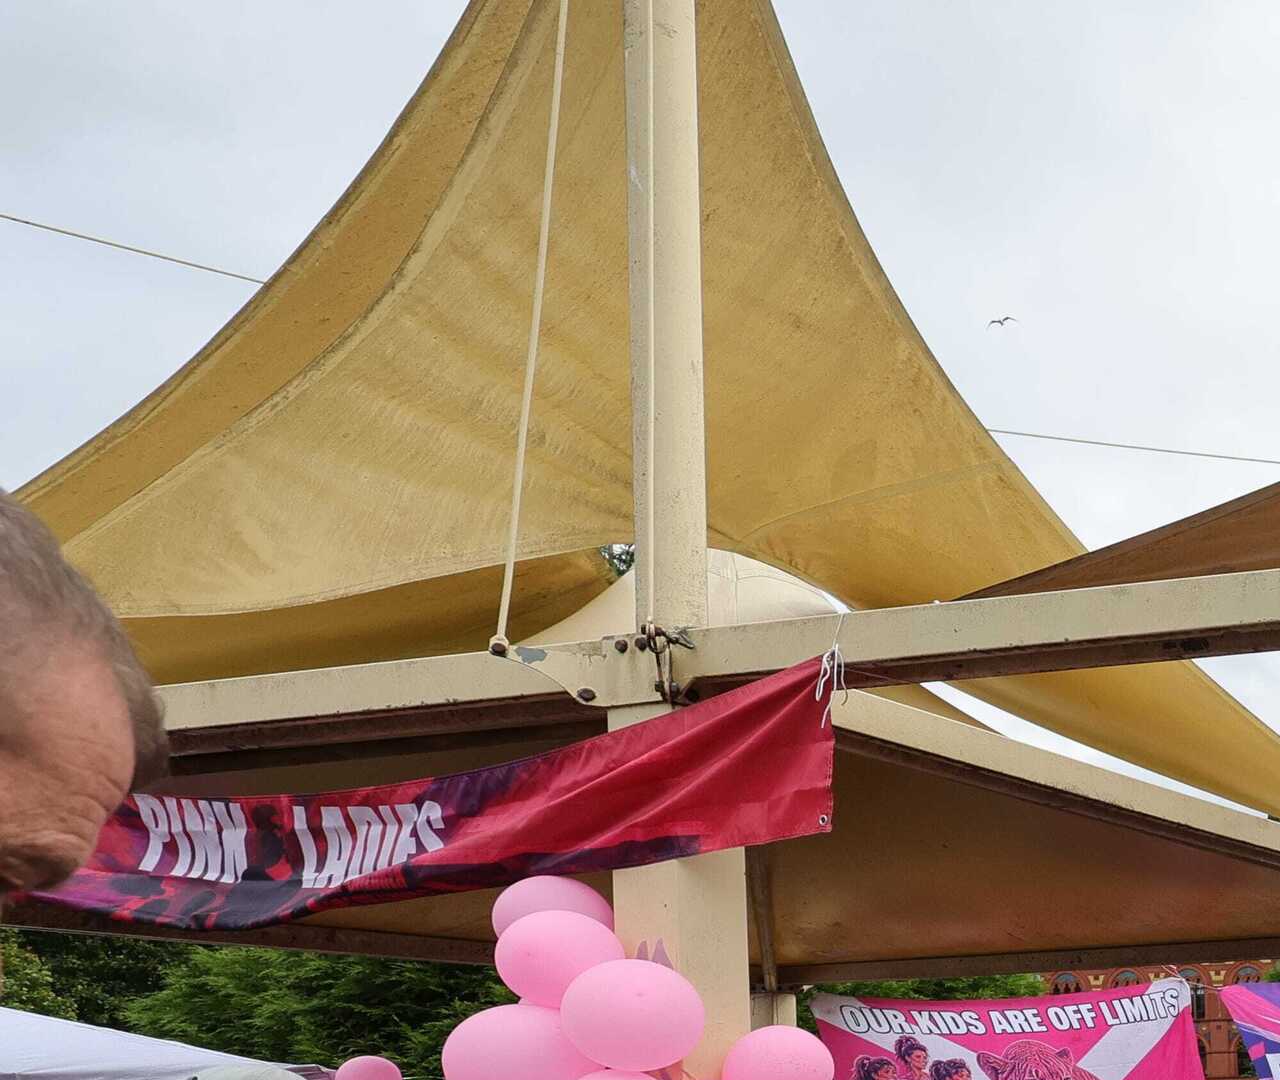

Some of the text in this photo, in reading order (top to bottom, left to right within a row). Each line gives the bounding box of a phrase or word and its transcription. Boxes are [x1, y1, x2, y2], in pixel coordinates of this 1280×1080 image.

[133, 794, 445, 888] PINK LADIES
[839, 986, 1180, 1036] OUR KIDS ARE OFF LIMITS
